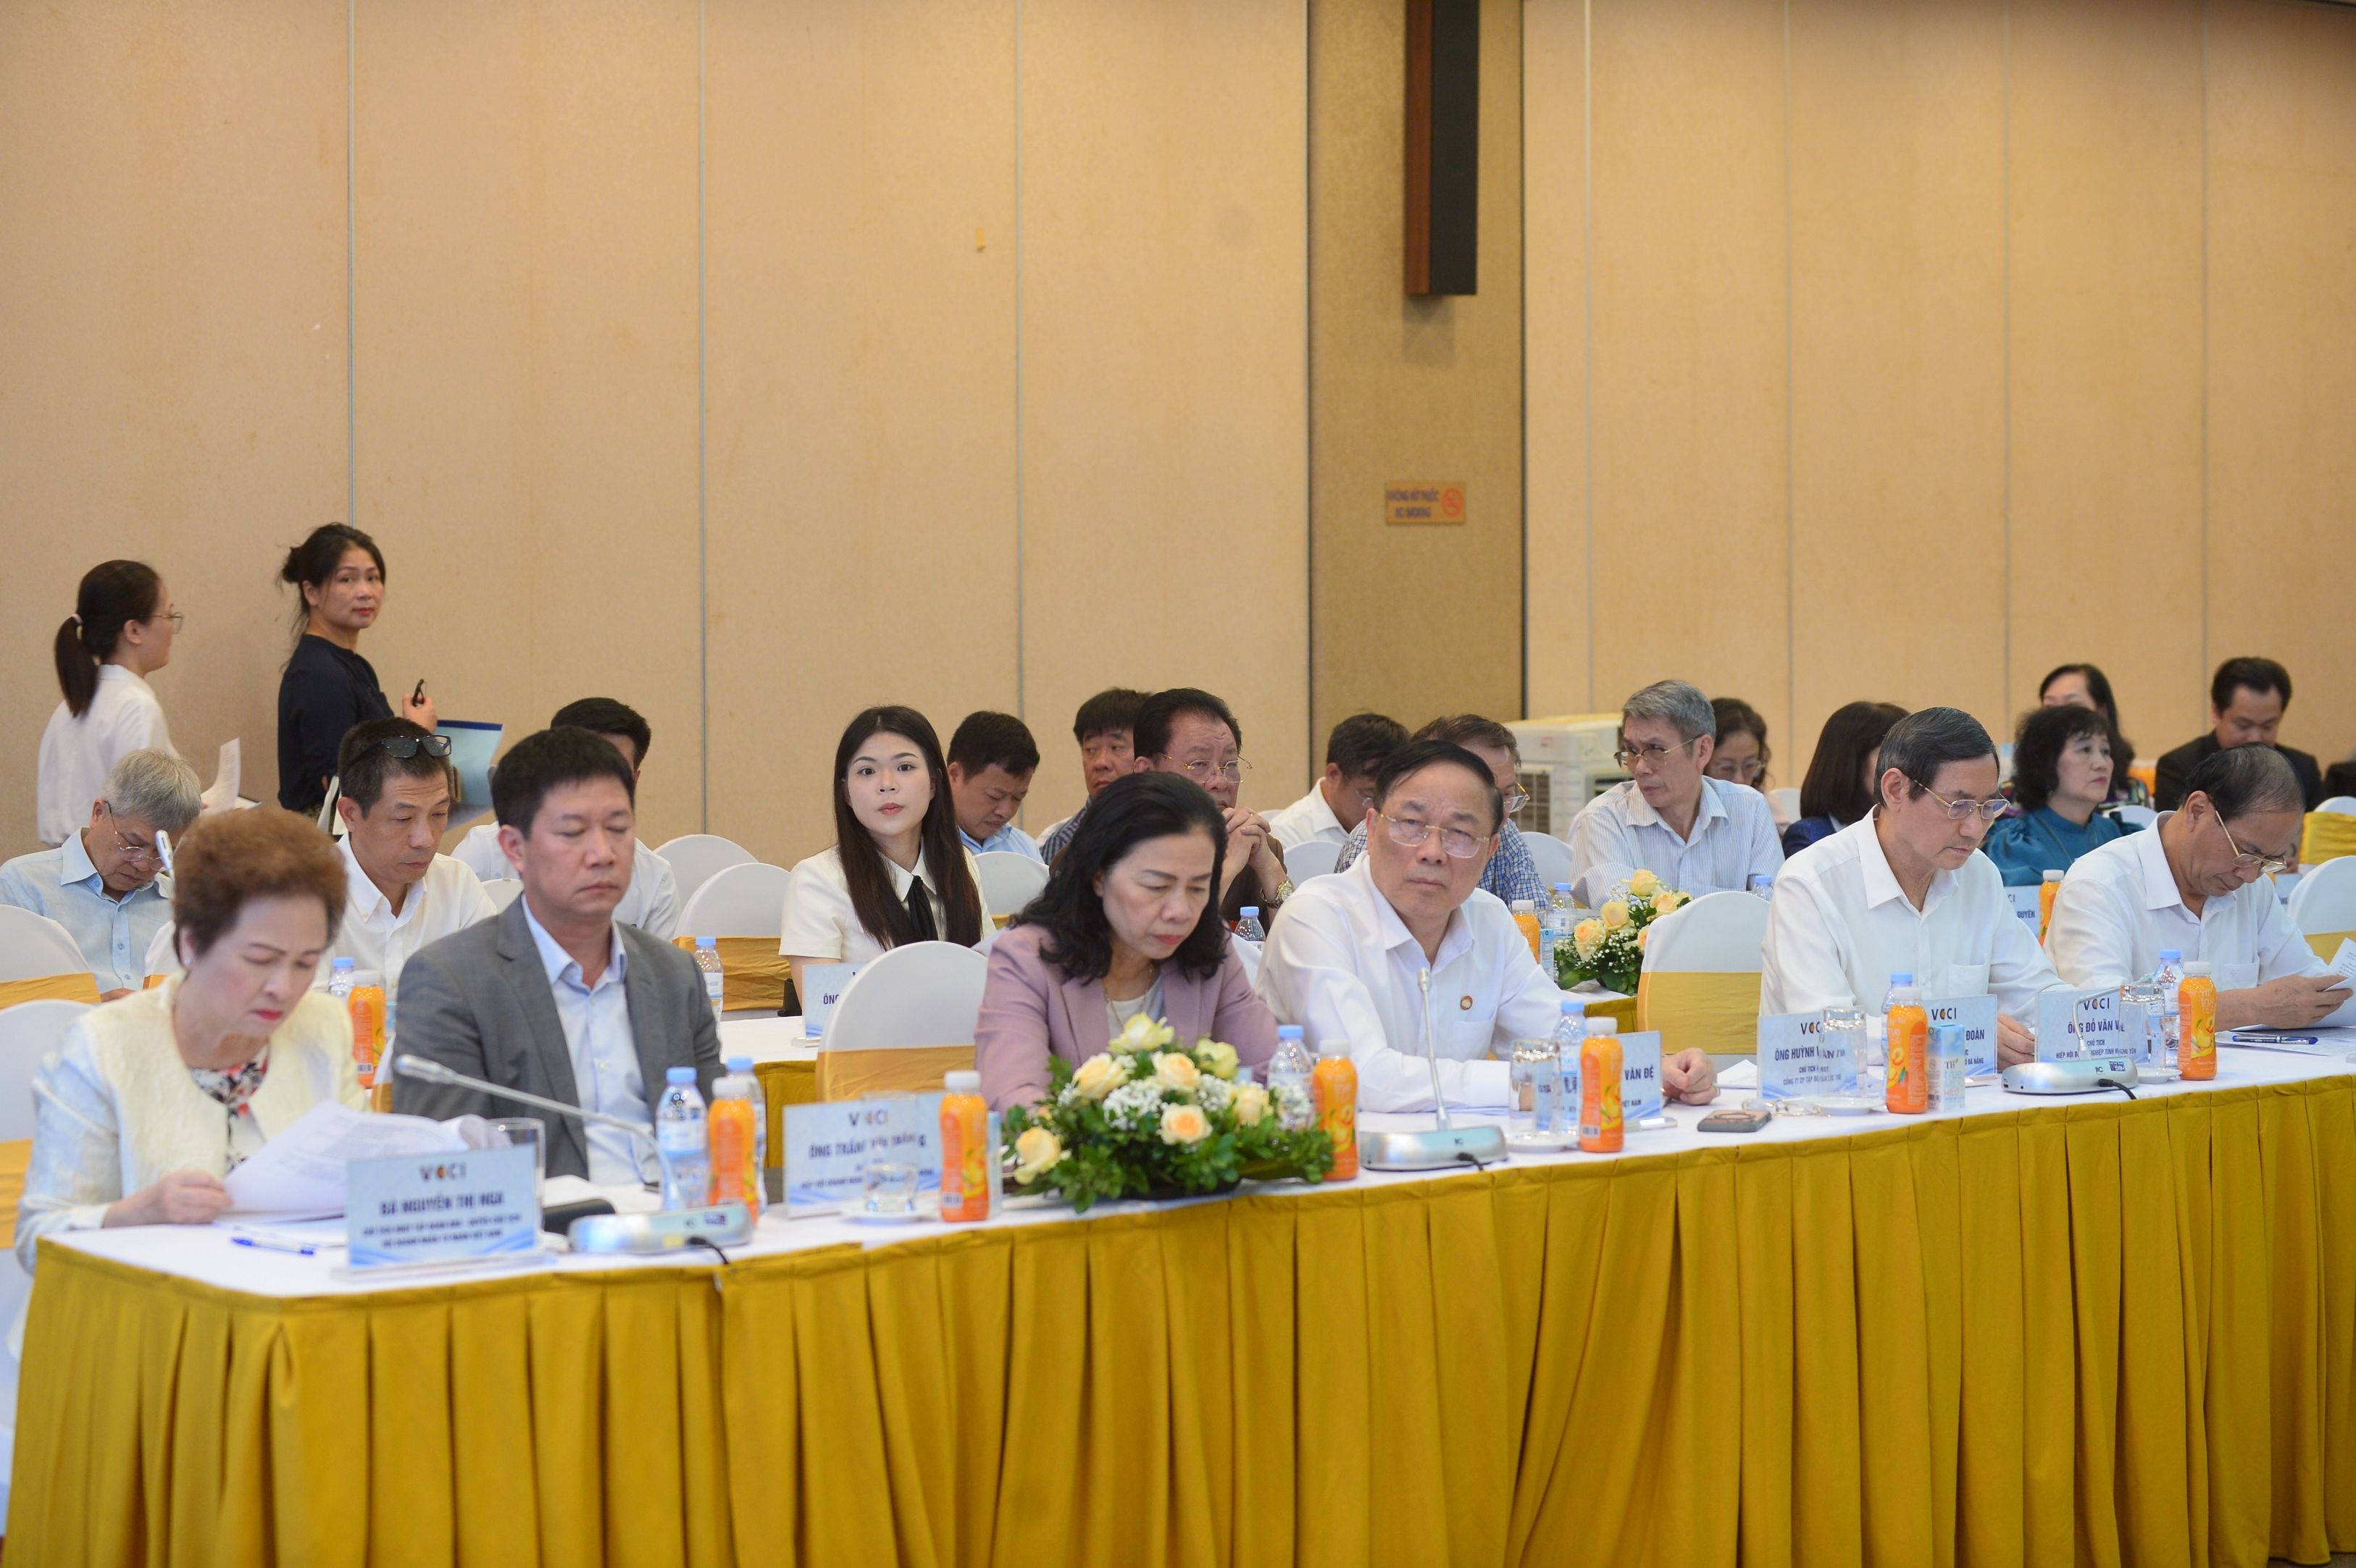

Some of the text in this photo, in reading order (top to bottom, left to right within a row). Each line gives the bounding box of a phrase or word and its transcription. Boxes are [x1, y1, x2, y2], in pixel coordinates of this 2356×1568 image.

[1931, 1007, 1957, 1020] VCCI
[1800, 1021, 1821, 1035] VCC
[2098, 1018, 2113, 1032] VĂN
[1966, 1027, 1985, 1041] ĐOÀN
[1775, 1047, 1789, 1060] ÔNG
[1791, 1045, 1815, 1059] HUỲNH
[1624, 1064, 1655, 1081] VĂN ĐỆ
